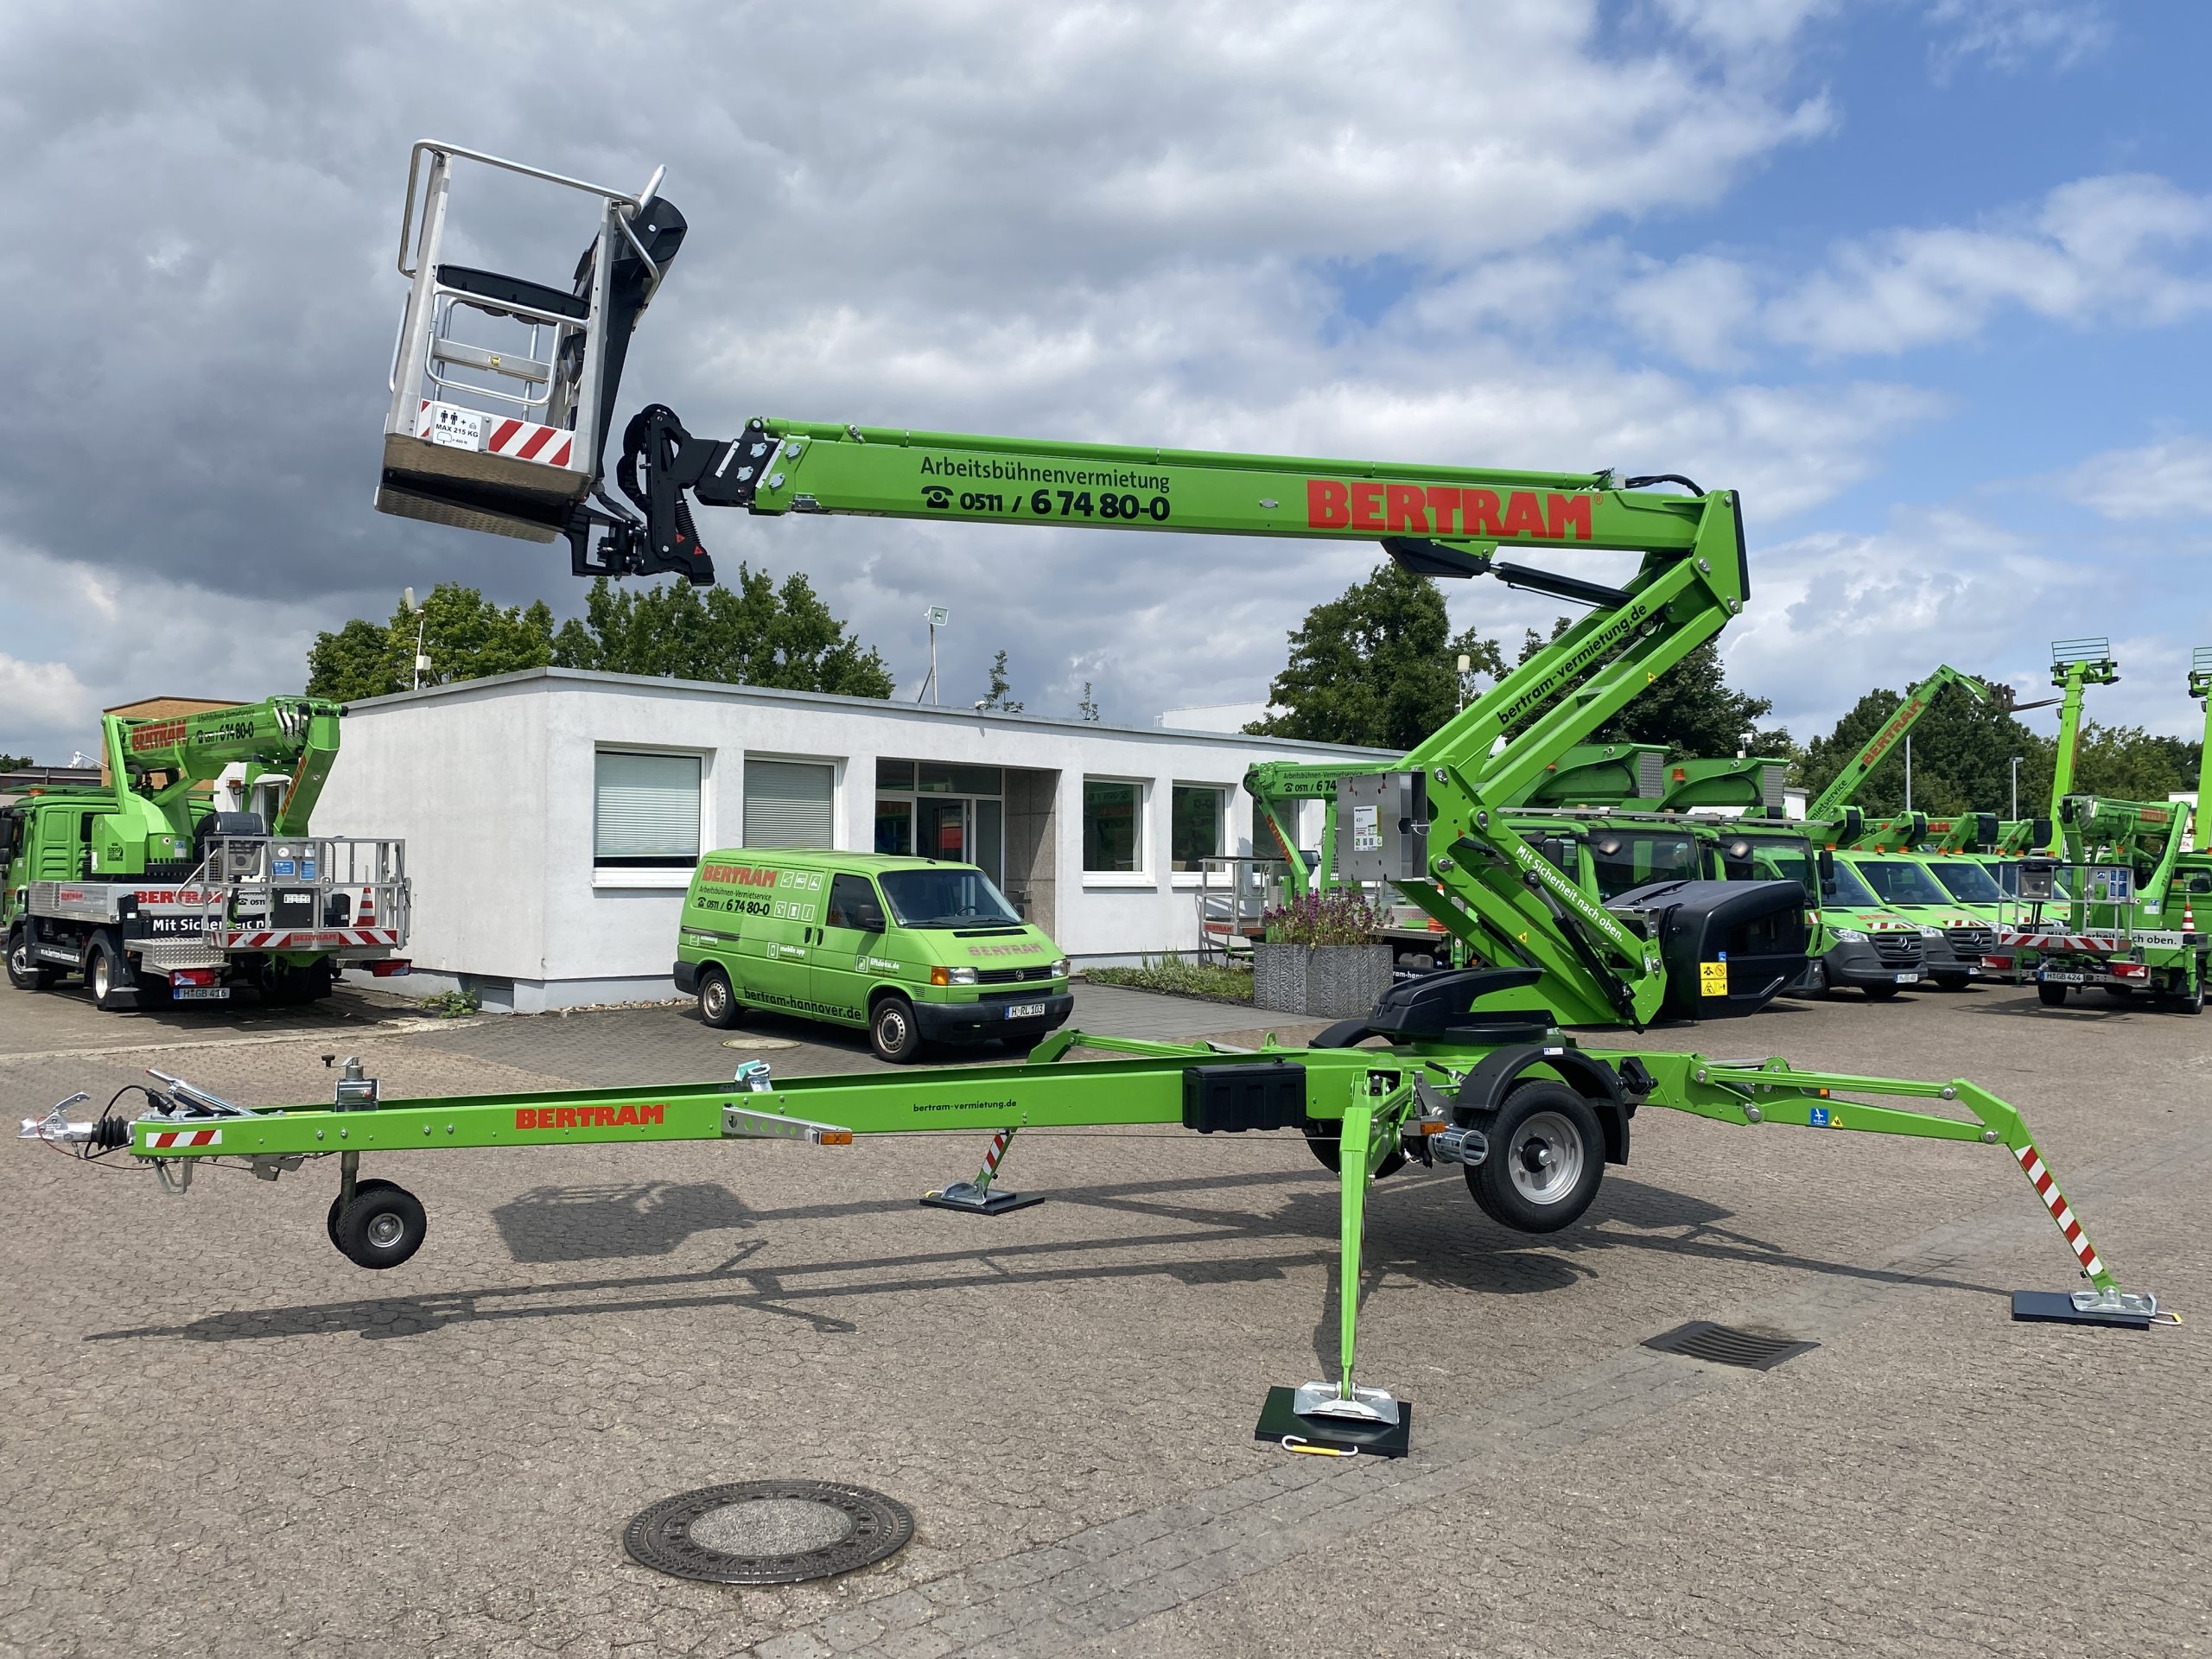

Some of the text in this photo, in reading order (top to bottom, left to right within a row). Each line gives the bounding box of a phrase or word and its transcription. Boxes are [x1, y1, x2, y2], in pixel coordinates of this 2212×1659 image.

[435, 423, 452, 432] MAX
[920, 456, 1170, 493] Arbeitsbühnenvermietung
[960, 492, 1002, 512] 0511
[1497, 604, 1647, 725] bertram-vermietung.de
[132, 718, 187, 752] BERTRAM
[1861, 698, 1923, 766] BERTRAM
[1294, 784, 1308, 792] 0511
[702, 864, 778, 888] BERTRAM
[699, 886, 772, 901] Arbeitsbühnen-Vermietservice
[1516, 845, 1623, 942] Mit Sicherheit nach oben.
[707, 899, 719, 909] 0511
[153, 919, 176, 931] Mit
[2147, 935, 2177, 945] oben.
[968, 942, 1044, 957] BERTRAM
[195, 989, 207, 998] GB
[209, 988, 226, 997] 416
[744, 986, 861, 1020] bertram-hannover.de
[1020, 1006, 1029, 1015] RL
[1031, 1004, 1043, 1014] 103
[913, 1099, 1017, 1112] bertram-vermietung.de
